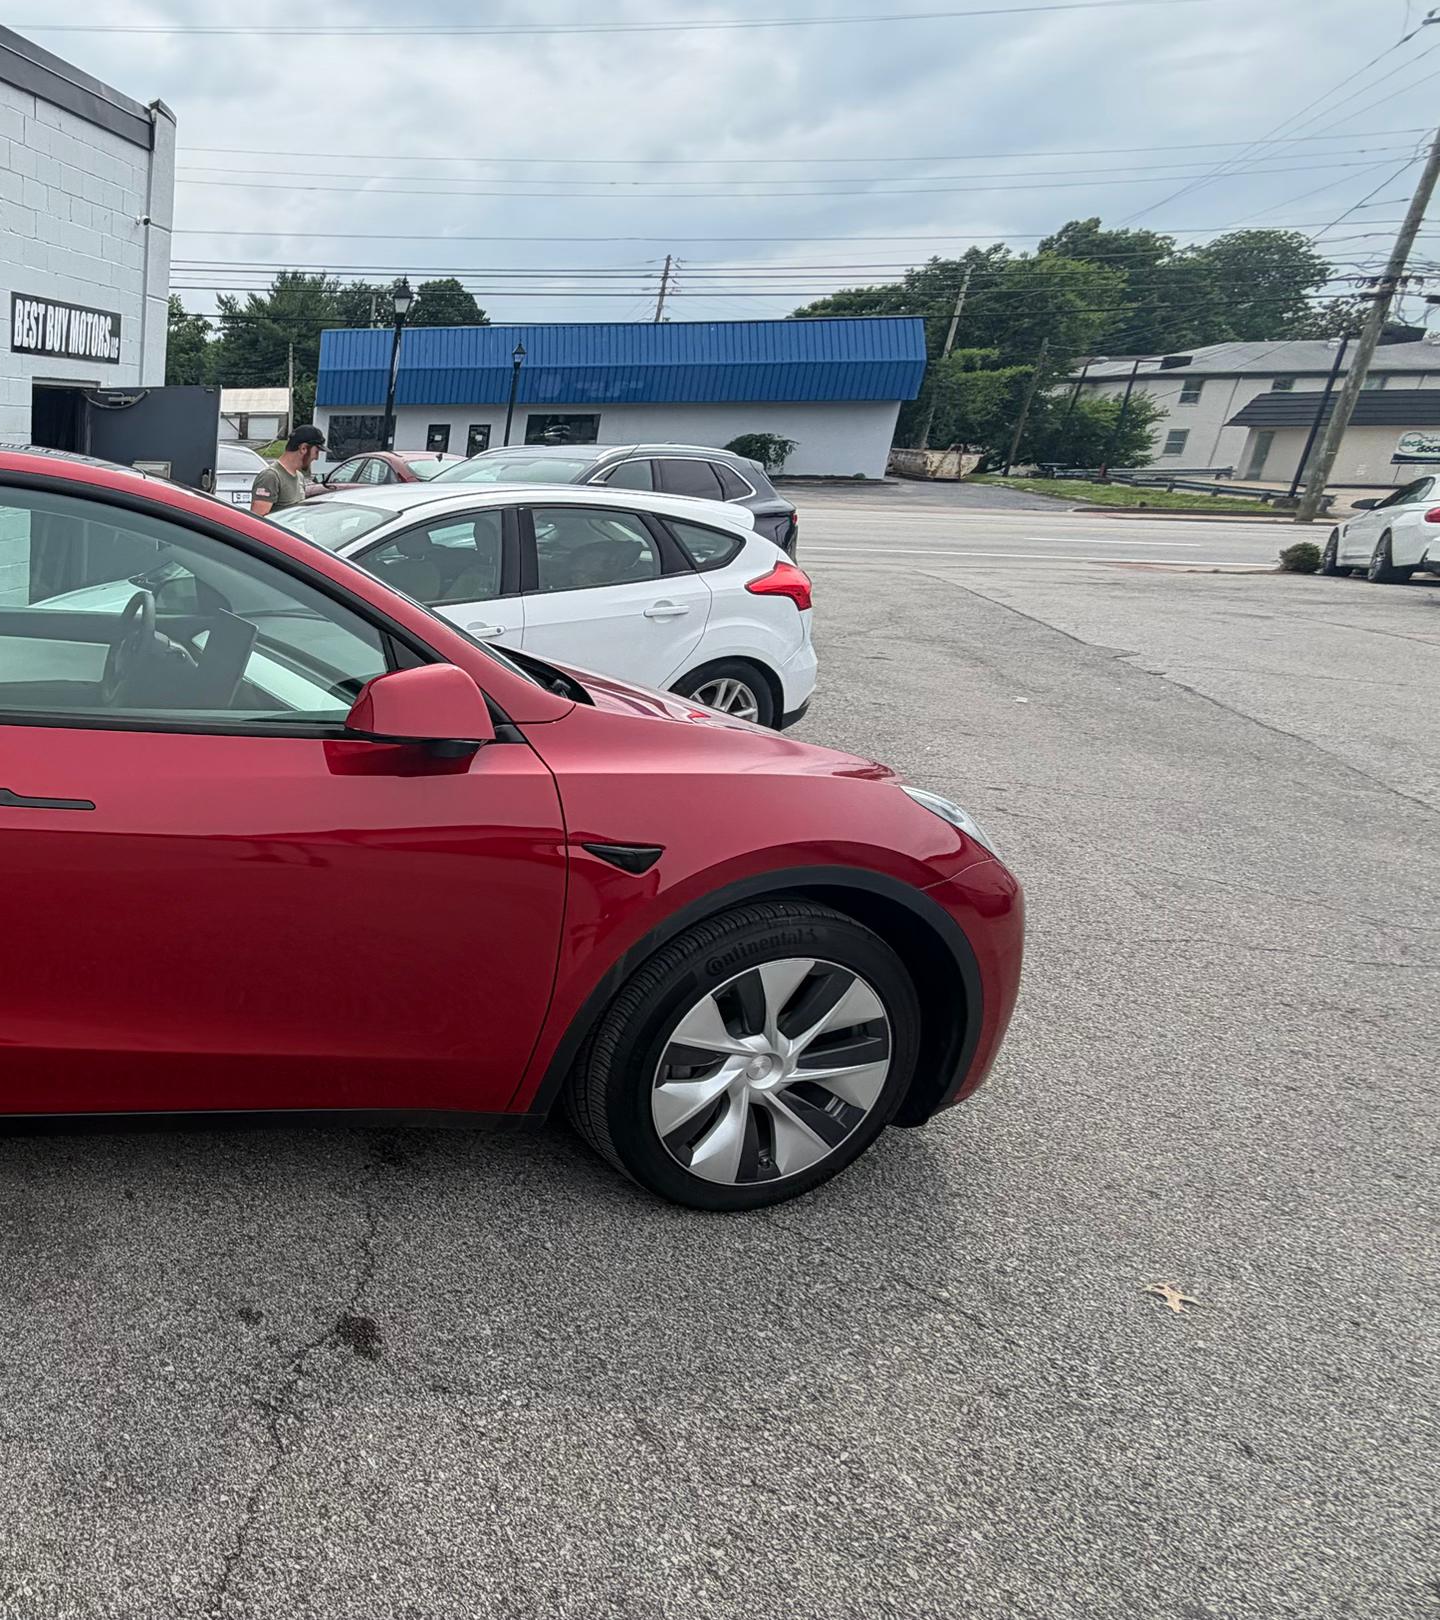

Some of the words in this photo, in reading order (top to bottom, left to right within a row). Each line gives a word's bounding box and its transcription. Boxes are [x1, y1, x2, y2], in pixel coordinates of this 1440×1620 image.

[14, 299, 45, 348] BEST
[46, 305, 69, 352] BUY
[69, 309, 111, 358] MOTORS
[706, 930, 803, 974] Continental
